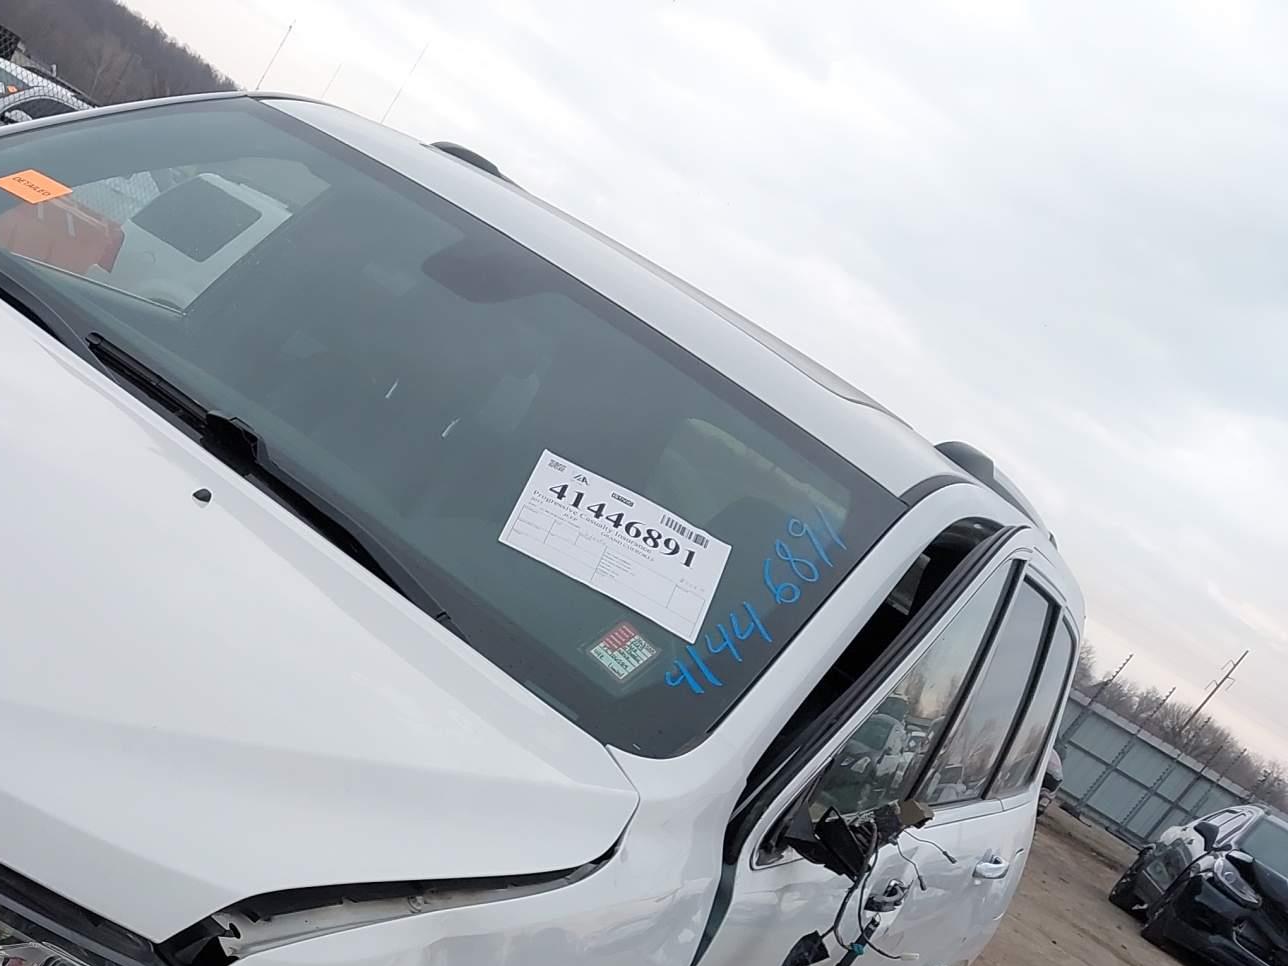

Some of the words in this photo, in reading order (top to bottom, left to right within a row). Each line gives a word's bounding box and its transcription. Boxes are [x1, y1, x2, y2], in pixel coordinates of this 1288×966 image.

[12, 176, 51, 196] DETAILED
[533, 489, 579, 517] Progressive
[579, 512, 612, 534] Casualty
[613, 530, 653, 554] Insurance
[548, 482, 696, 569] 41446891
